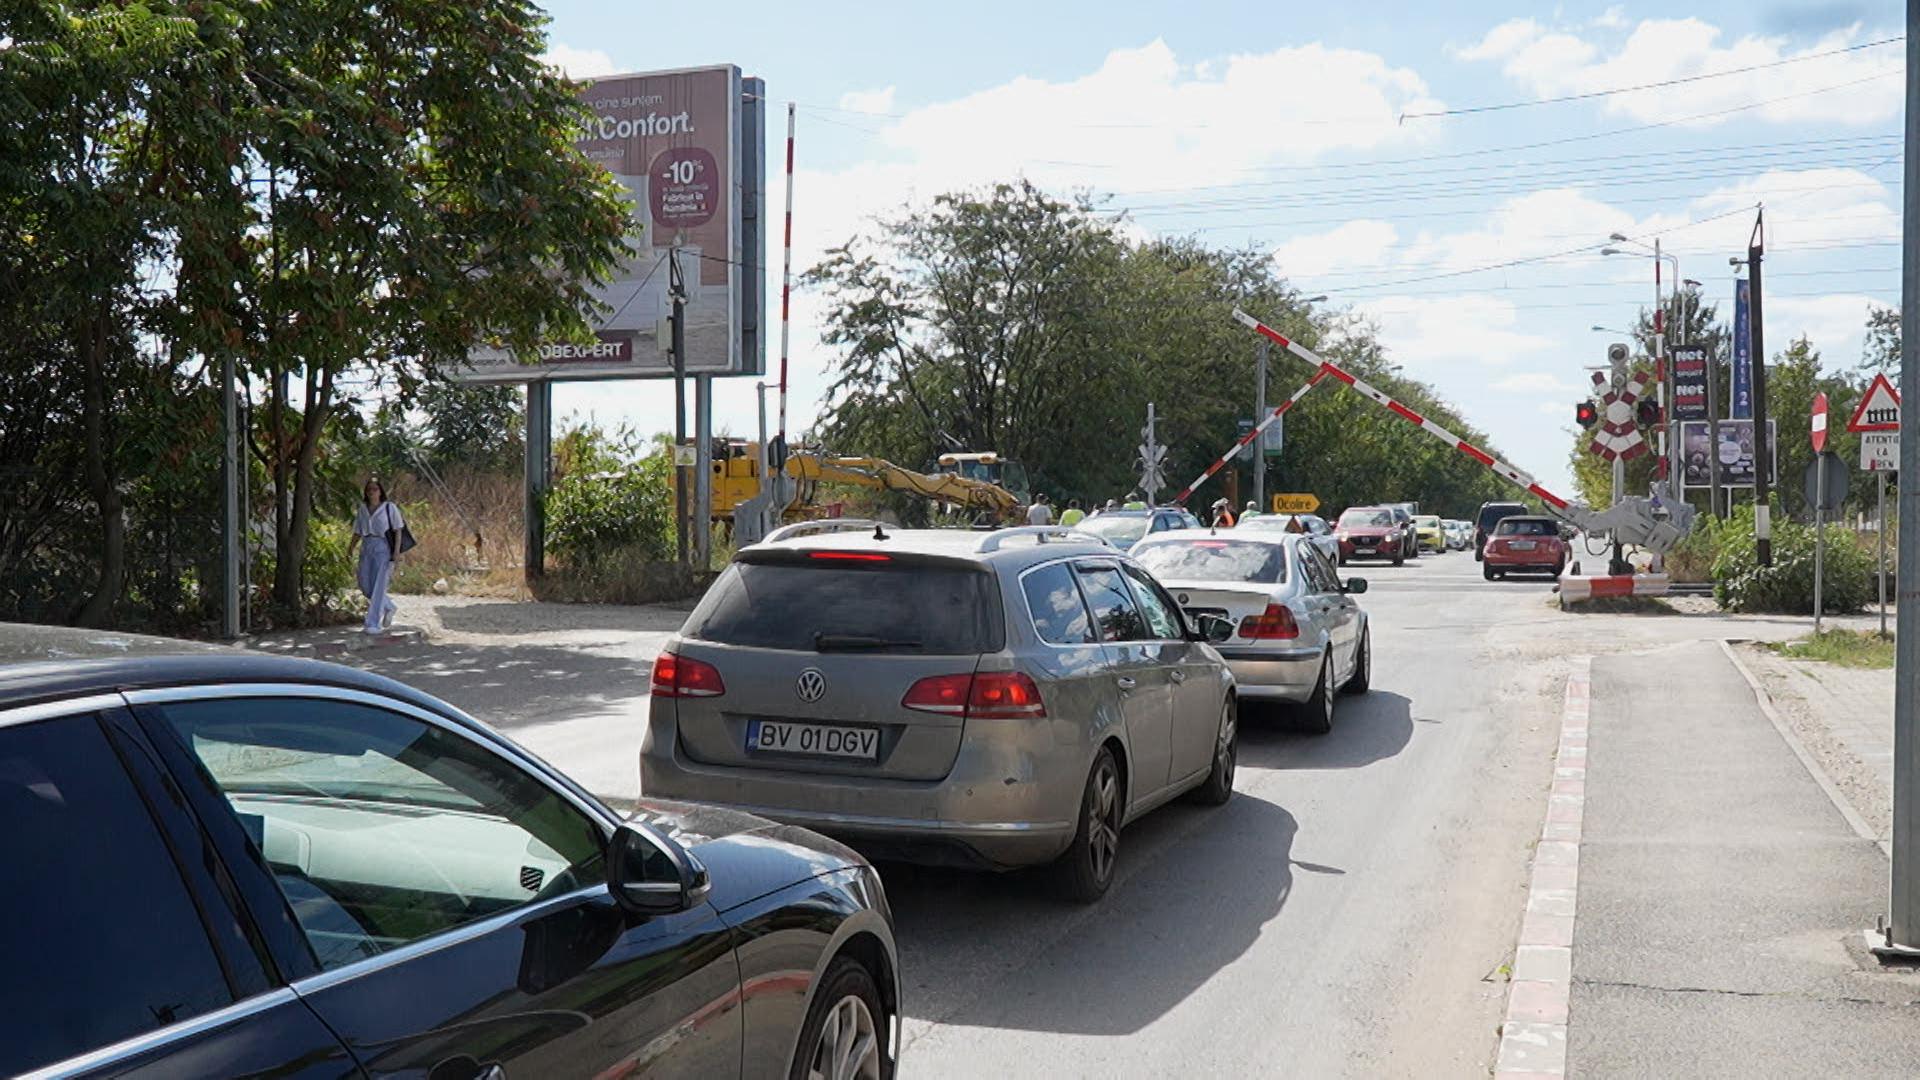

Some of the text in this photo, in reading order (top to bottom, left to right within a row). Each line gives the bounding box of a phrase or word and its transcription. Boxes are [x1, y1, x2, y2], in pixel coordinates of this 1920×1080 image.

[600, 111, 695, 140] Confort.
[761, 725, 792, 747] BV
[800, 727, 822, 750] 01
[826, 730, 874, 754] DGV
